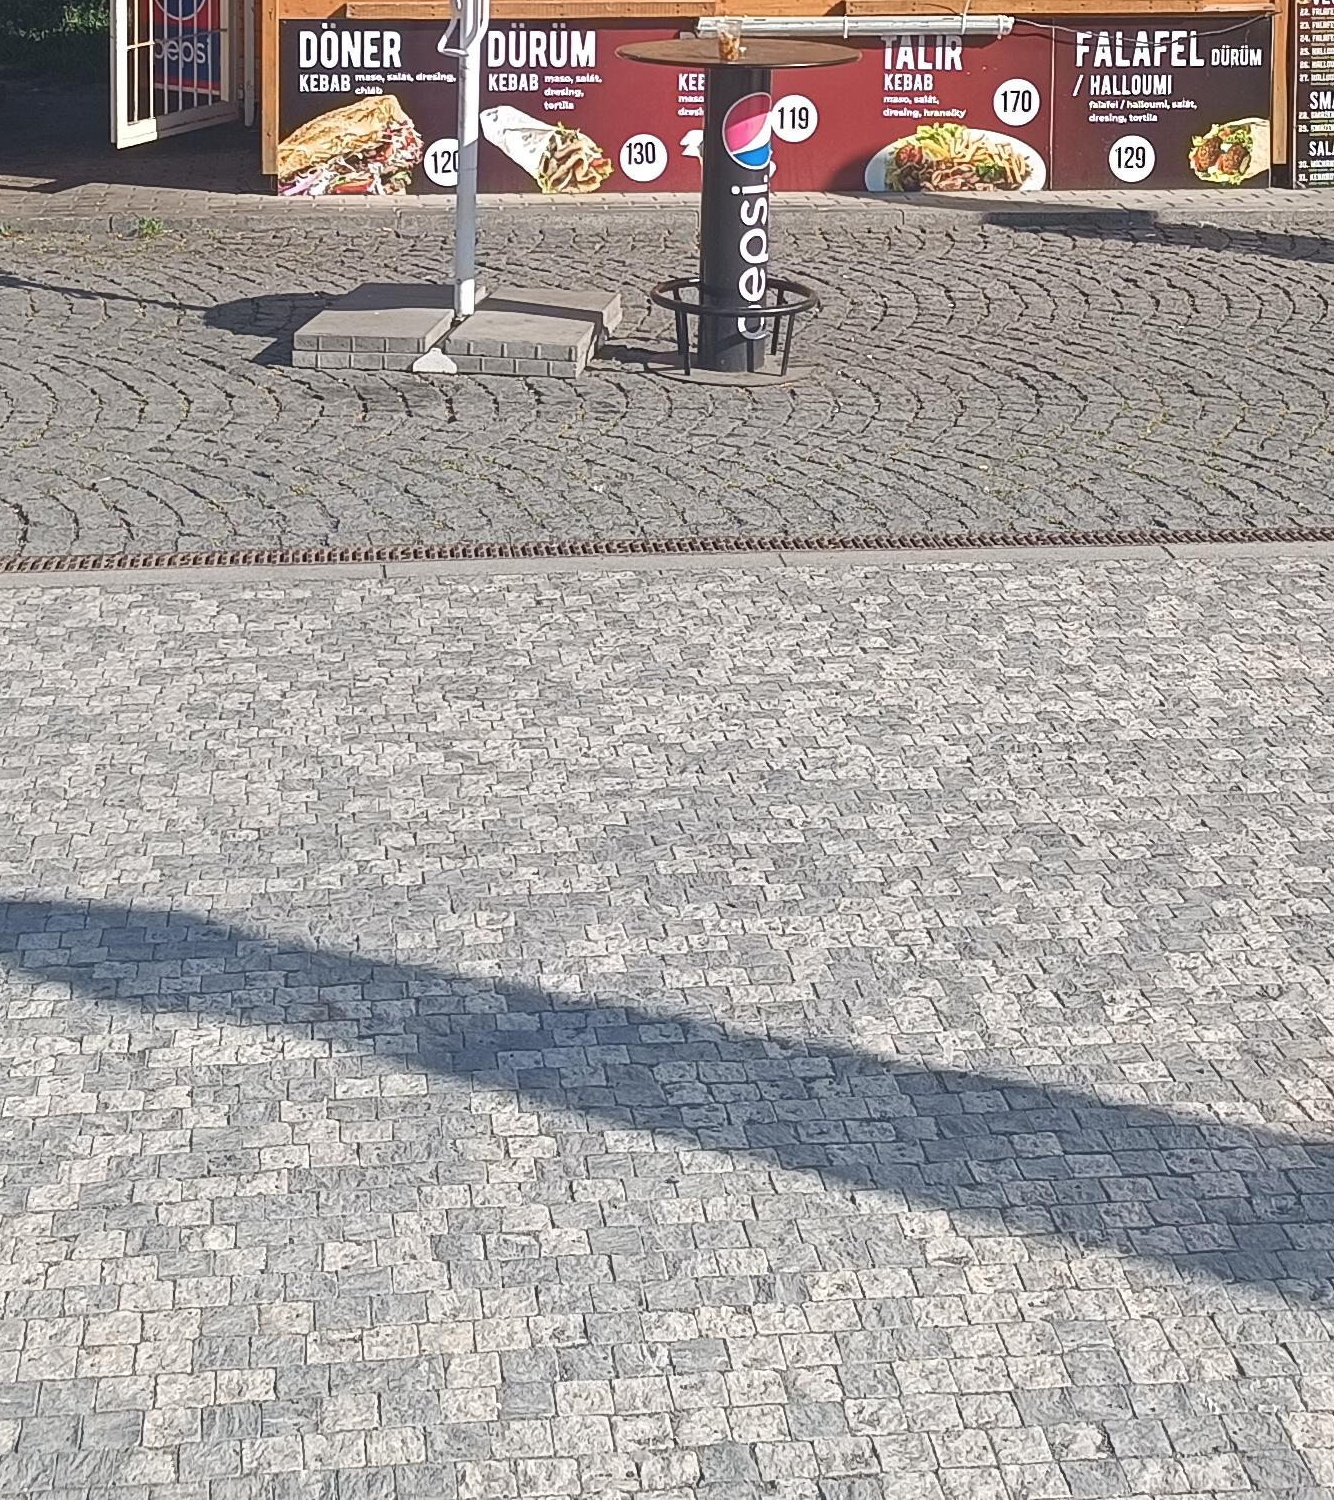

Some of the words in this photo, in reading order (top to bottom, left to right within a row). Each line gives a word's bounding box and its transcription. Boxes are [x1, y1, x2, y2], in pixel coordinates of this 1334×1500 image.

[299, 23, 402, 69] DÖNER
[487, 22, 596, 68] DÜRÜM
[1075, 30, 1205, 67] FALAFEL
[1211, 44, 1263, 66] DÜRÜM
[299, 73, 351, 93] KEBAB
[488, 73, 539, 92] KEBAB
[883, 73, 934, 92] KEBAB
[1090, 74, 1172, 96] HALLOUMI
[1001, 89, 1032, 113] 170
[777, 106, 809, 130] 119
[626, 141, 656, 166] 130
[1115, 146, 1146, 169] 129
